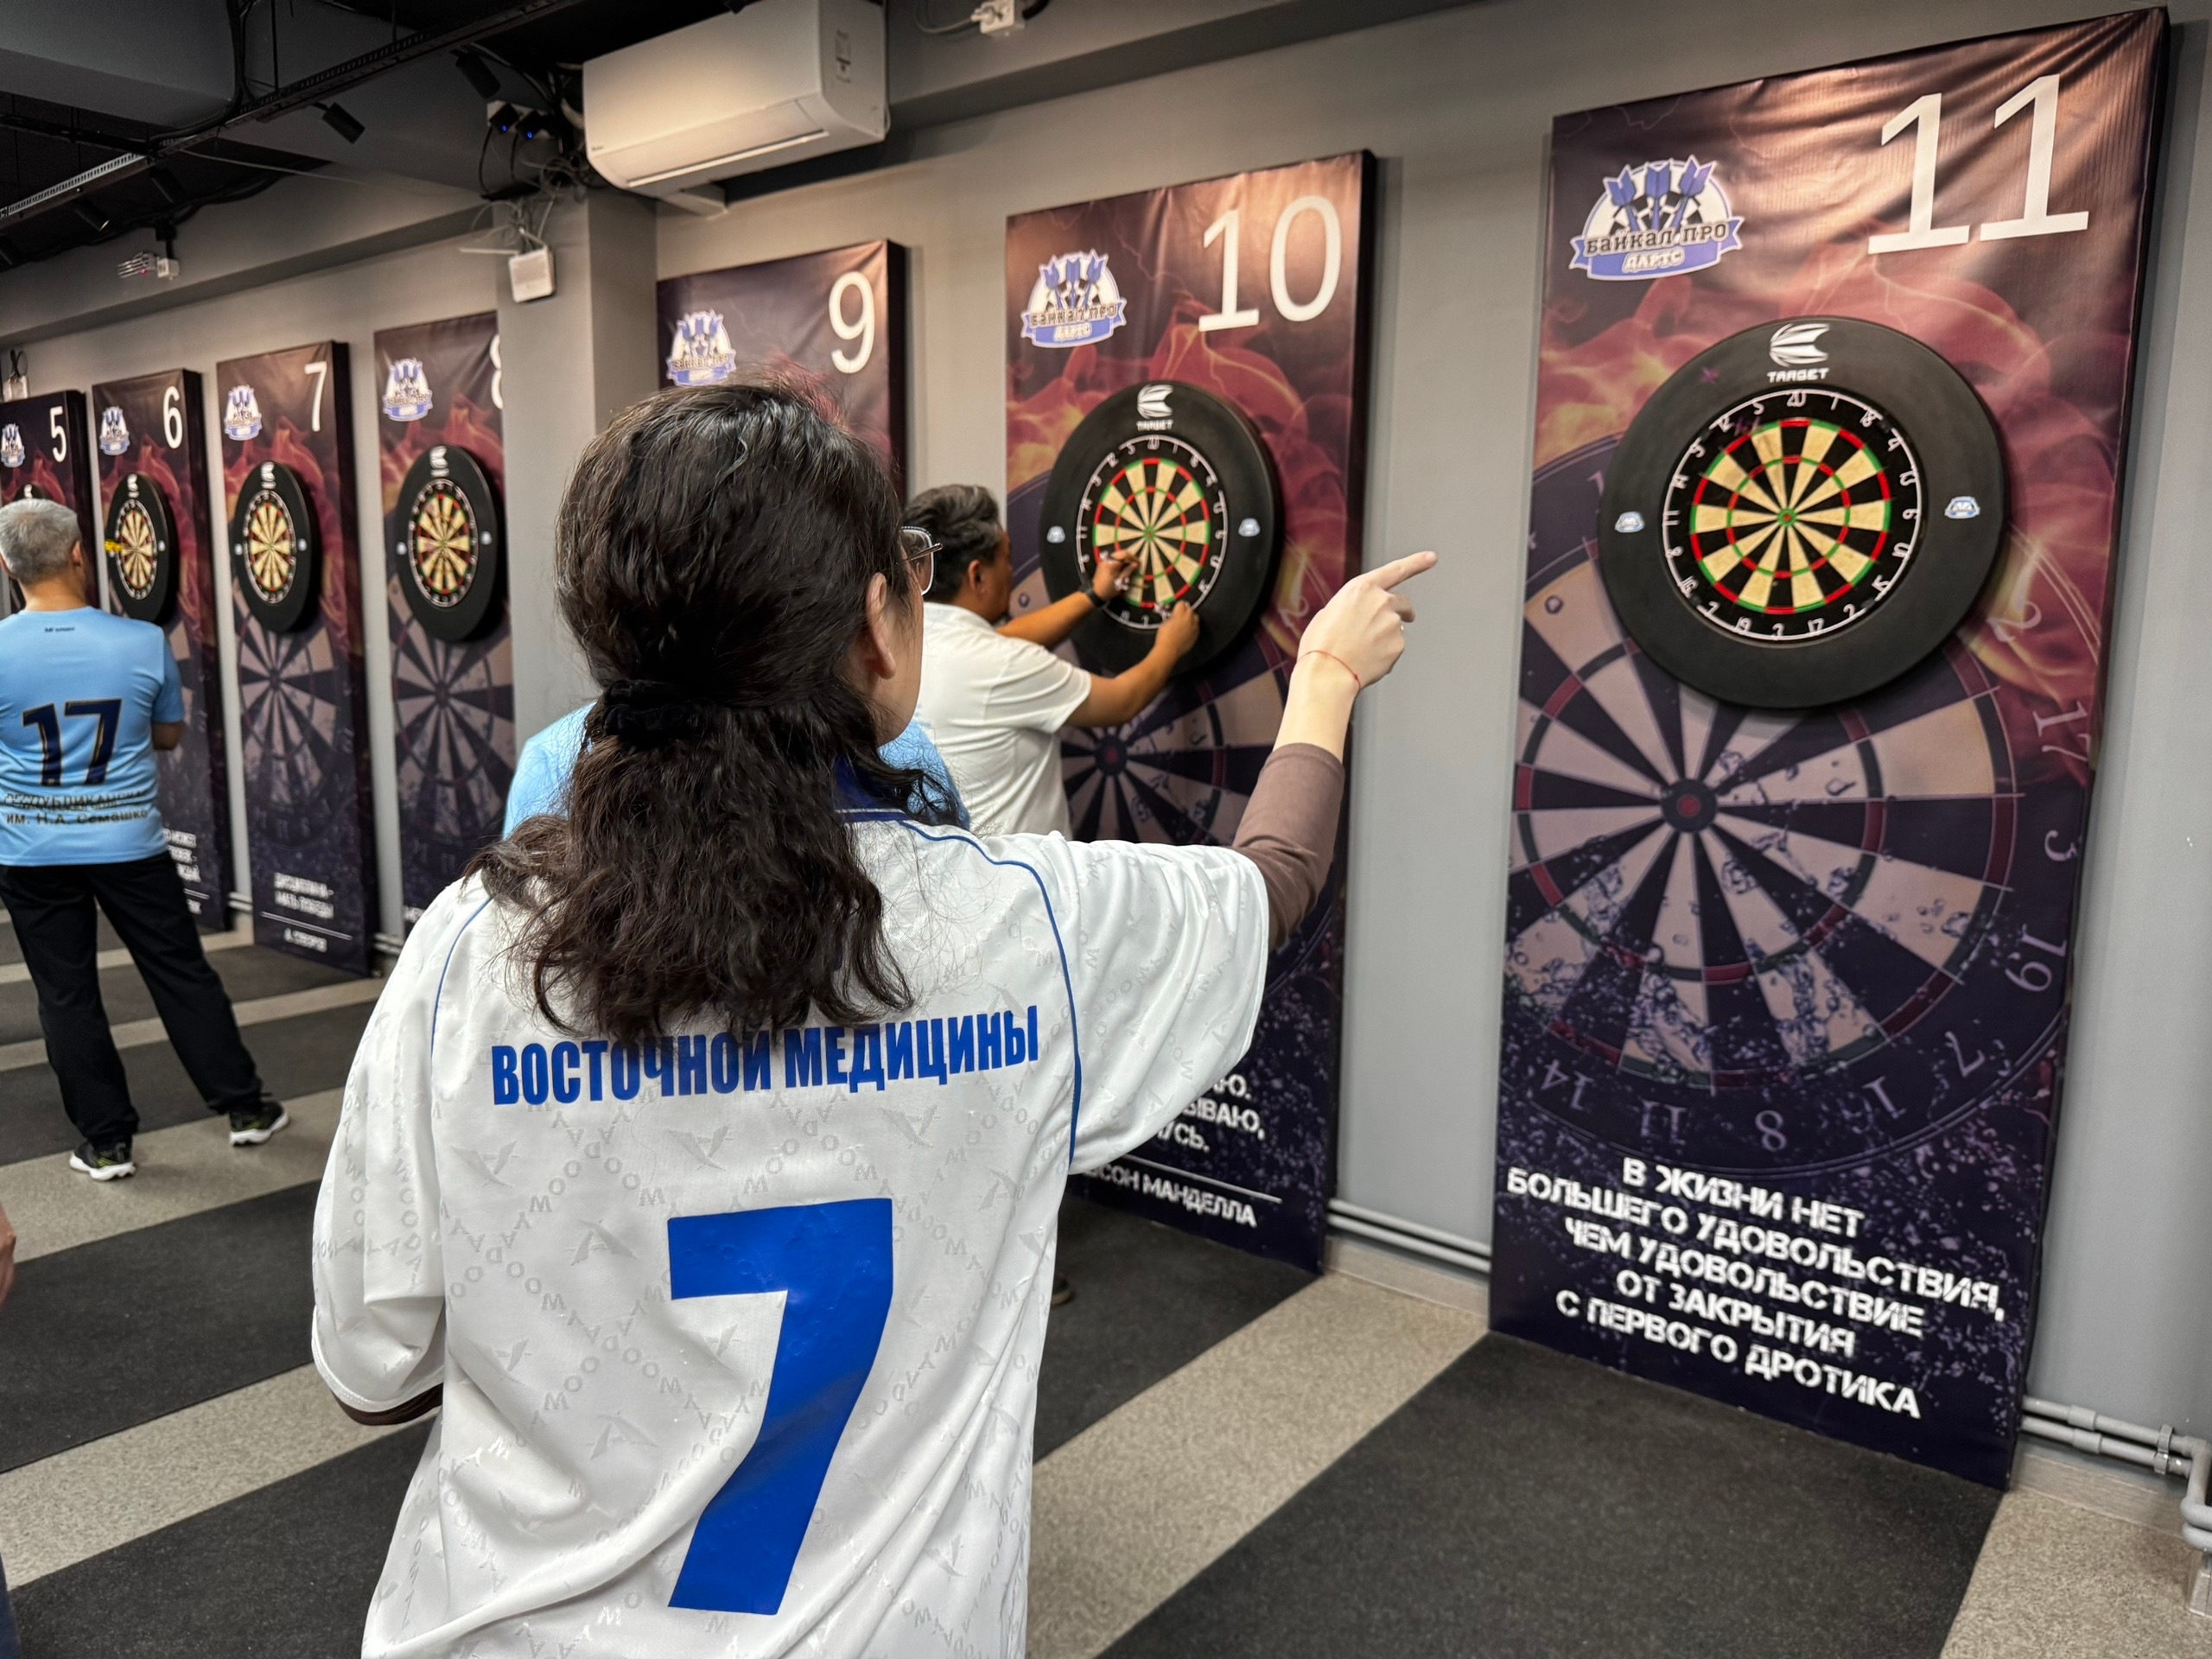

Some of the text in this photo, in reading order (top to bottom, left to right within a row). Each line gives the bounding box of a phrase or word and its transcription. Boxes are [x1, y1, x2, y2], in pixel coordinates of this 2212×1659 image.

[1867, 73, 2089, 255] 11
[1198, 194, 1343, 334] 10
[1684, 222, 1727, 242] ПРО
[828, 270, 875, 374] 9
[163, 385, 183, 449] 6
[304, 360, 327, 432] 7
[1766, 367, 1830, 384] TARGET
[49, 405, 67, 462] 5
[22, 698, 123, 787] 17
[783, 1005, 1039, 1093] МЕДИЦИНЫ
[1753, 1109, 1788, 1152] 8
[1142, 1173, 1258, 1229] МАНДЕЛЛА
[1623, 1156, 1866, 1238] В ЖИЗНИ НЕТ
[1506, 1166, 2005, 1323] БОЛЬШЕГО УДОВОЛЬСТВИЯ,
[1564, 1217, 1926, 1339] ЧЕМ УДОВОЛЬСТВИЕ
[1555, 1289, 1923, 1420] С ПЕРВОГО ДРОТИКА
[1616, 1268, 1857, 1359] ОТ ЗАКРЫТИЯ
[667, 1198, 894, 1616] 7
